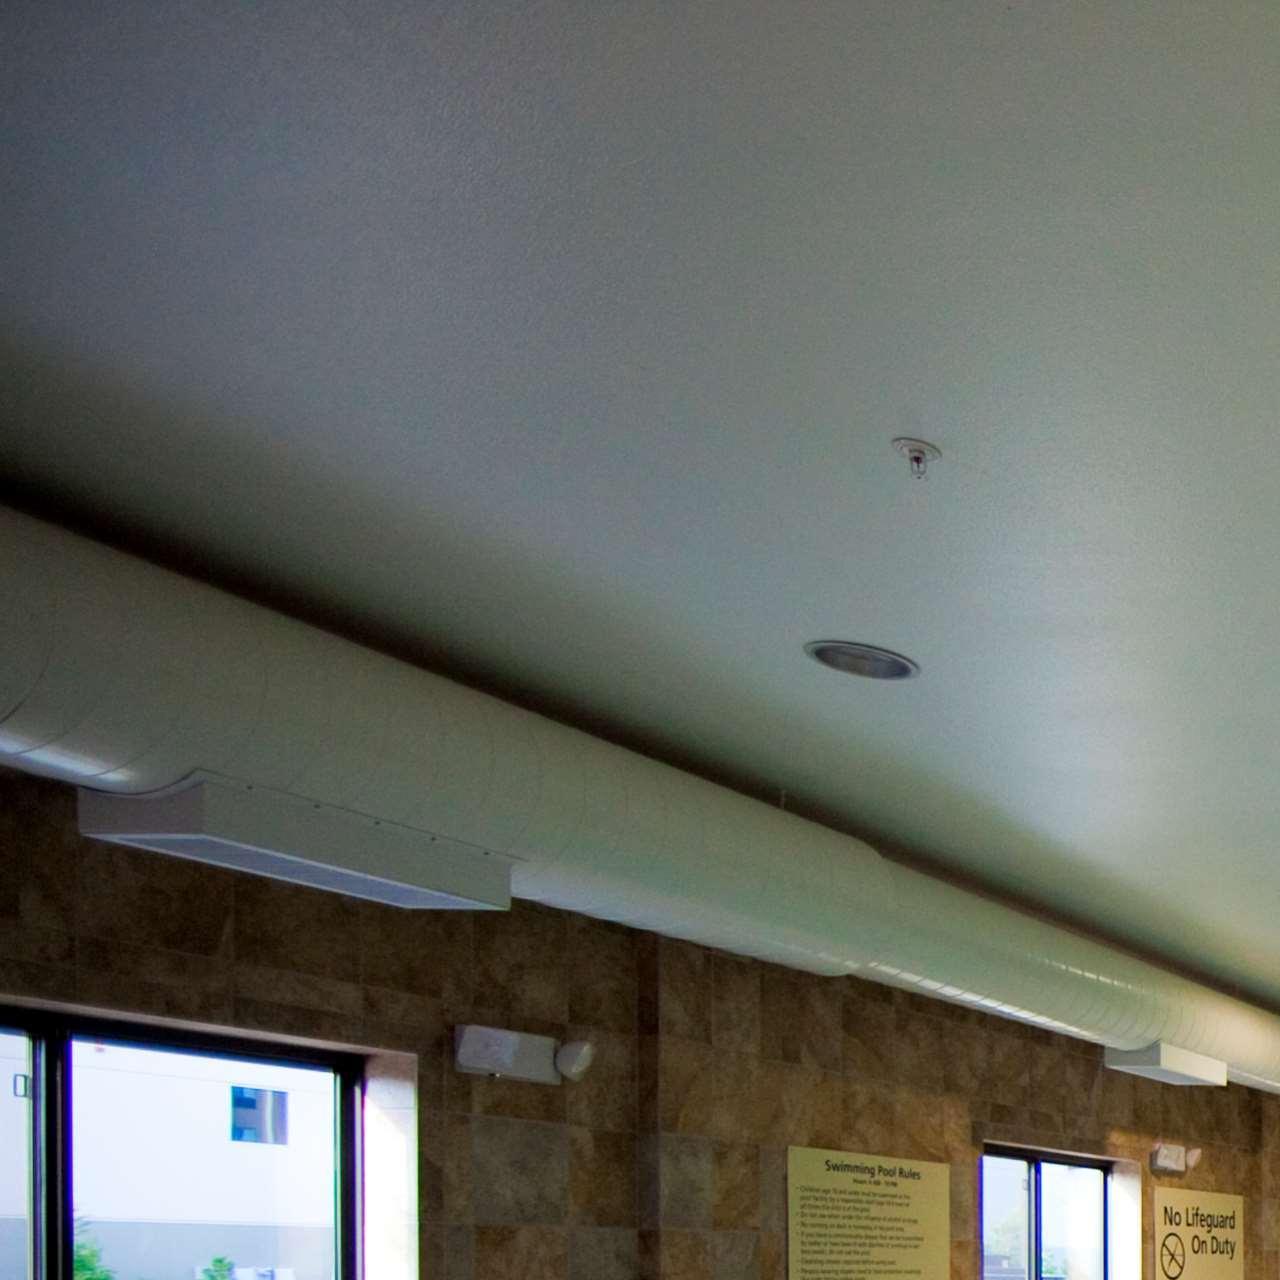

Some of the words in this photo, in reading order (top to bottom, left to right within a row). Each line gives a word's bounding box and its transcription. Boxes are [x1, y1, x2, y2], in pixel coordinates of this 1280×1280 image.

[825, 1159, 875, 1178] Swimming
[877, 1165, 897, 1178] Pool
[899, 1167, 921, 1180] Rules
[1163, 1206, 1182, 1226] No
[1185, 1206, 1236, 1233] Lifeguard
[1191, 1235, 1207, 1254] On
[1210, 1236, 1236, 1260] Duty
